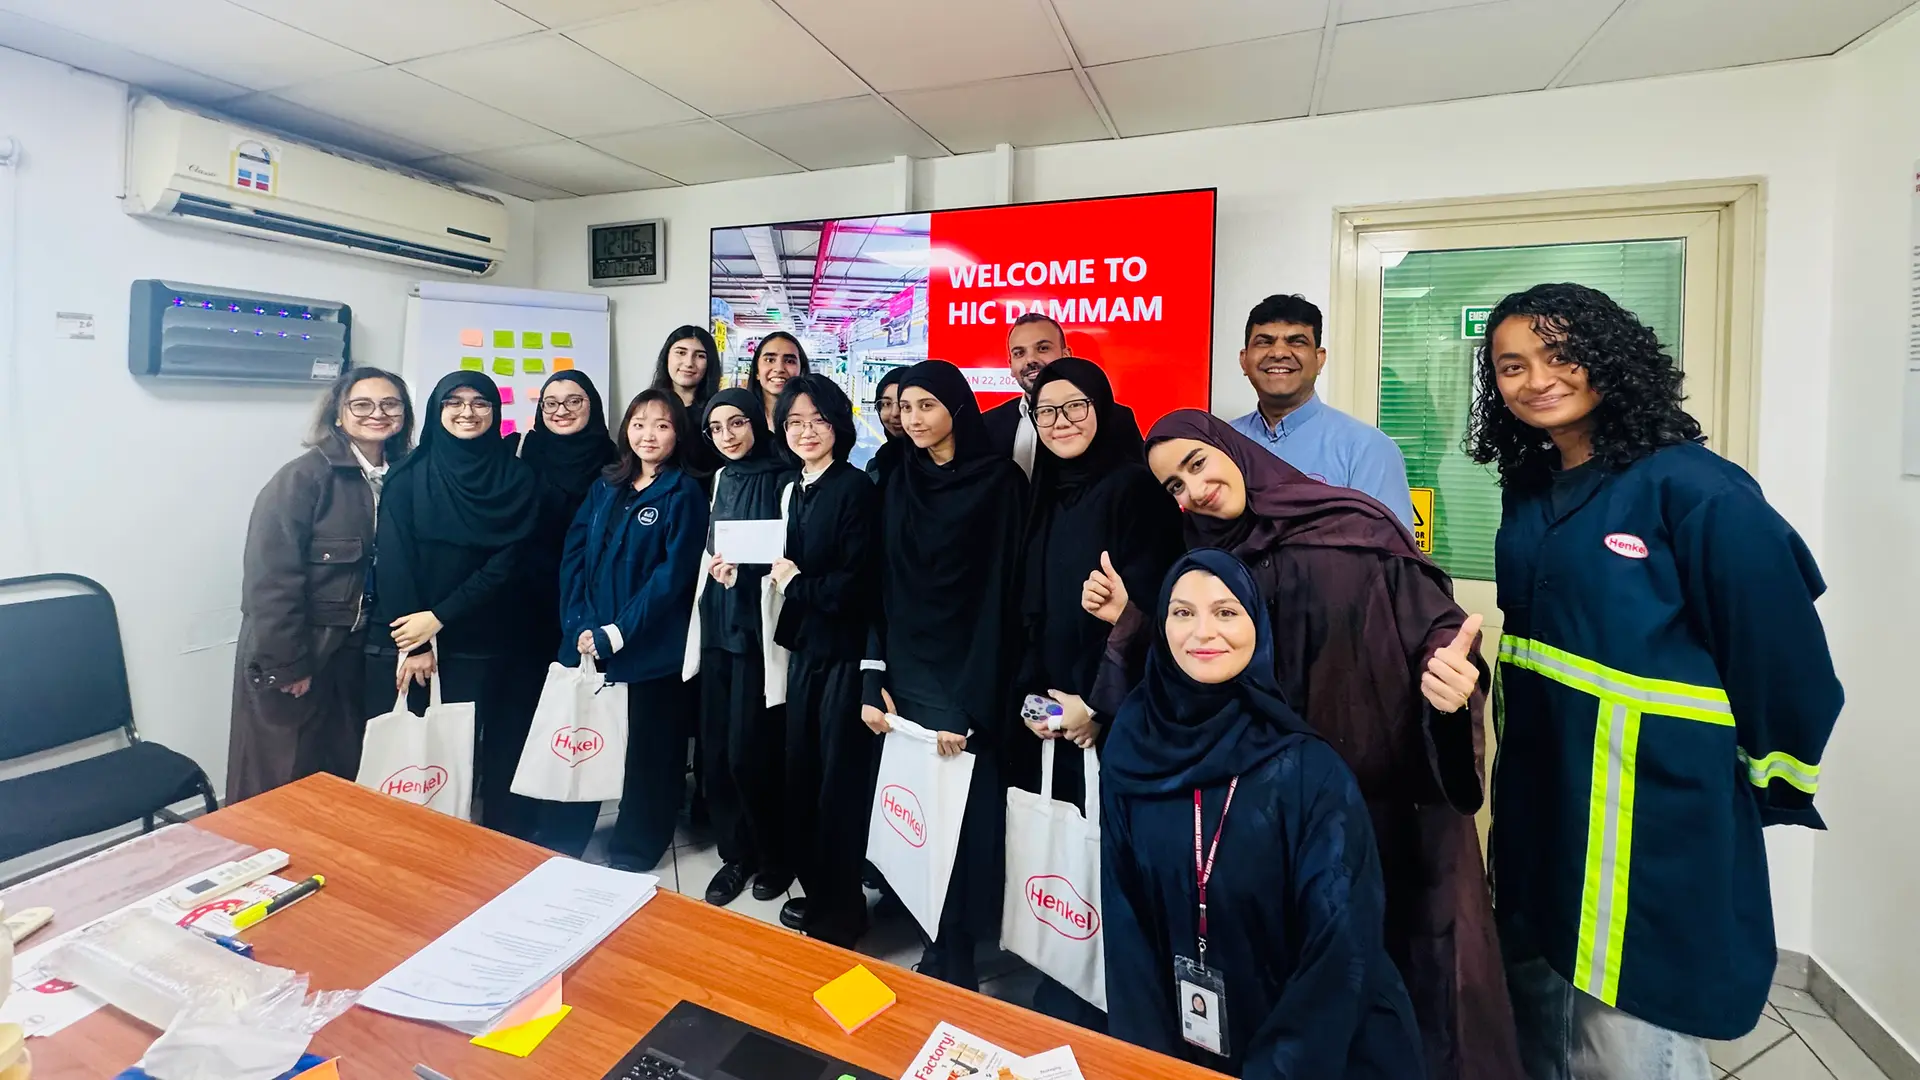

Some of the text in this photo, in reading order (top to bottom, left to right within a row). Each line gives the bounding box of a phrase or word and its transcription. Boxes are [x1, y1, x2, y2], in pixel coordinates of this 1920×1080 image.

[948, 256, 1147, 289] WELCOME TO
[948, 296, 1163, 325] HIC DAMMAM
[1468, 311, 1490, 321] EMER
[1474, 323, 1488, 334] EX
[966, 376, 1018, 387] AN 22, 202
[1414, 531, 1425, 539] OR
[1415, 540, 1426, 548] RE
[387, 771, 442, 795] Henkel
[883, 791, 925, 840] Henkel
[1030, 883, 1092, 931] Henkel
[914, 1031, 956, 1080] Factory!
